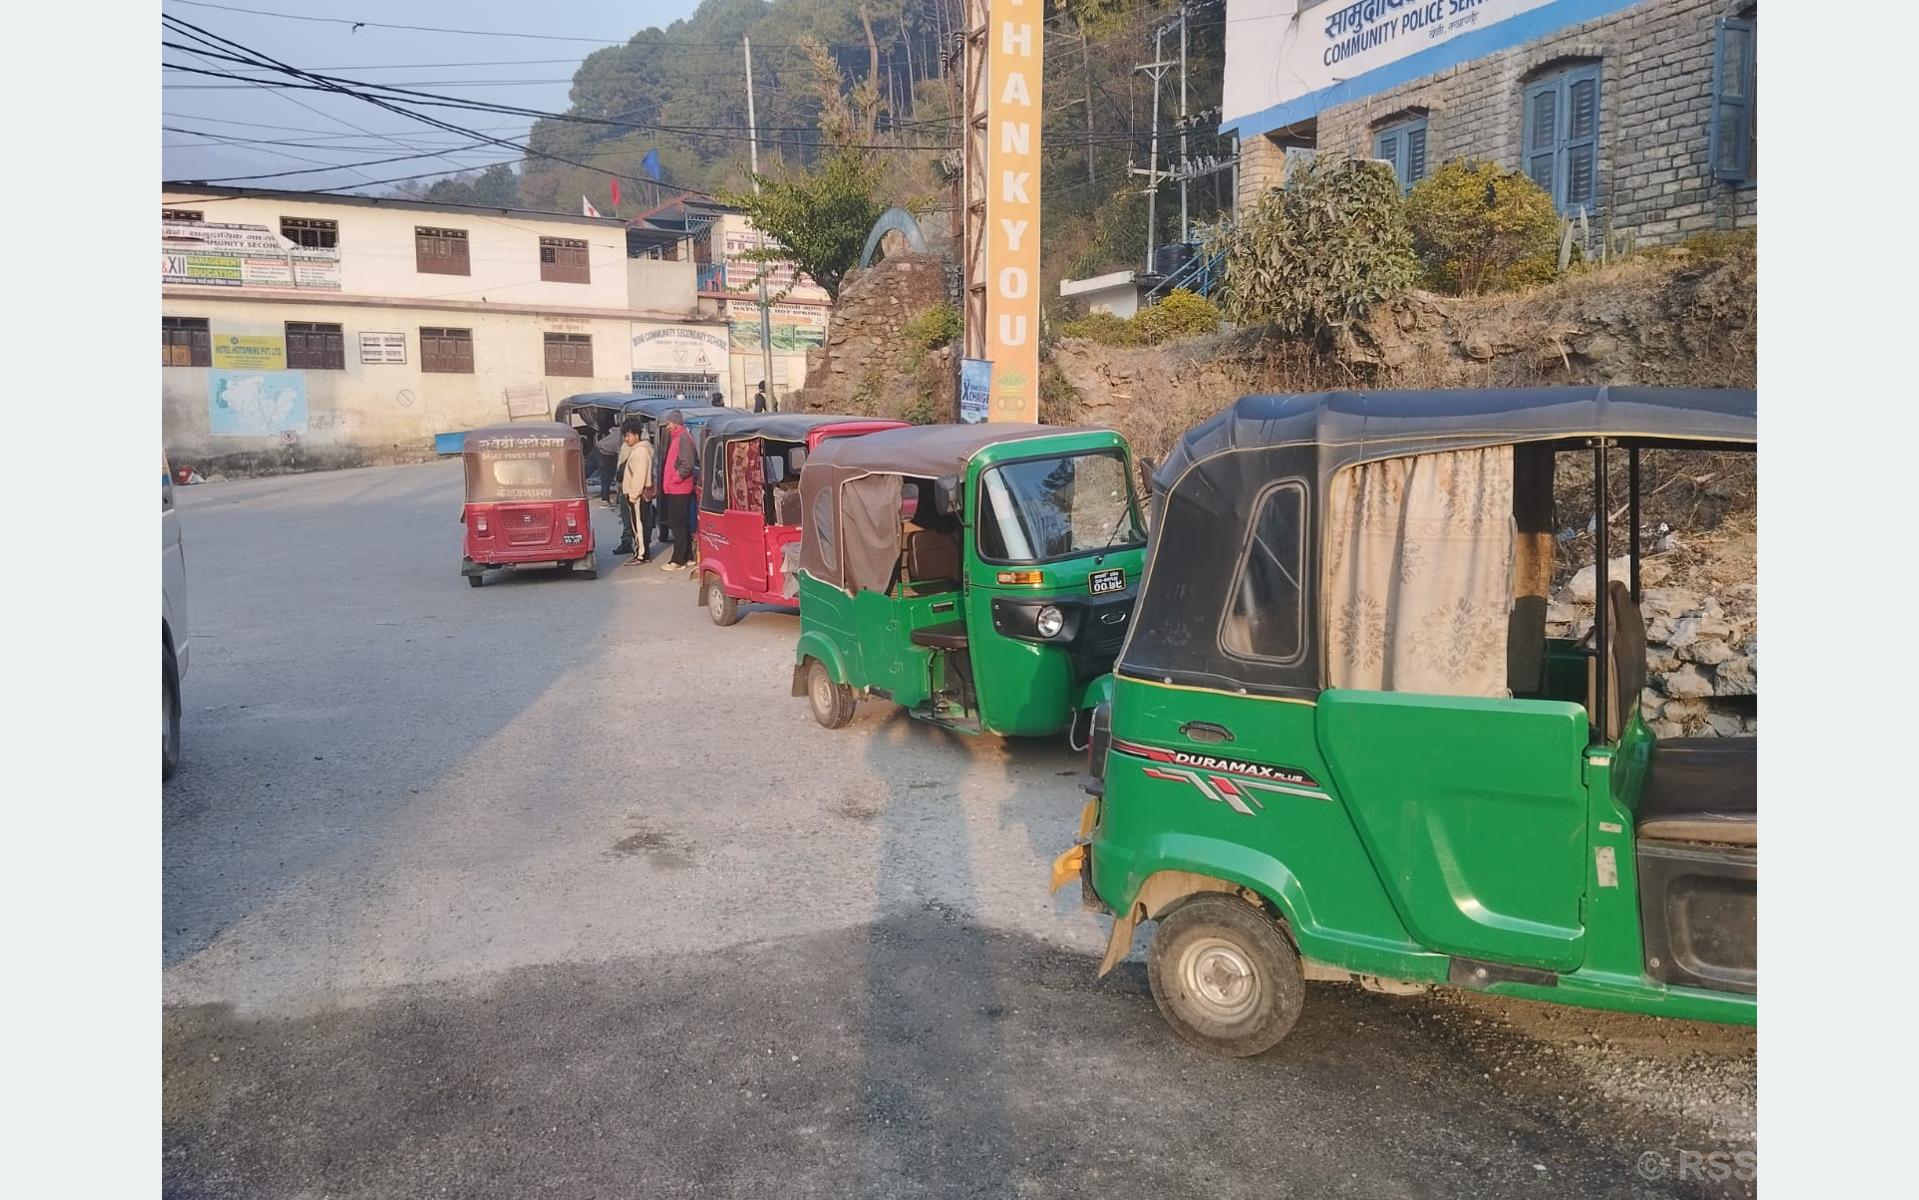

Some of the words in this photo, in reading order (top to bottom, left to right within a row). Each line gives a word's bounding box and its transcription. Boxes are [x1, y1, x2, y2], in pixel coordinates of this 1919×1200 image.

[1323, 17, 1399, 67] COMMUNITY
[1402, 0, 1443, 35] POLICE
[998, 0, 1032, 347] HANKYOU
[1174, 752, 1274, 778] DURAMAX
[1274, 772, 1303, 783] PLUS
